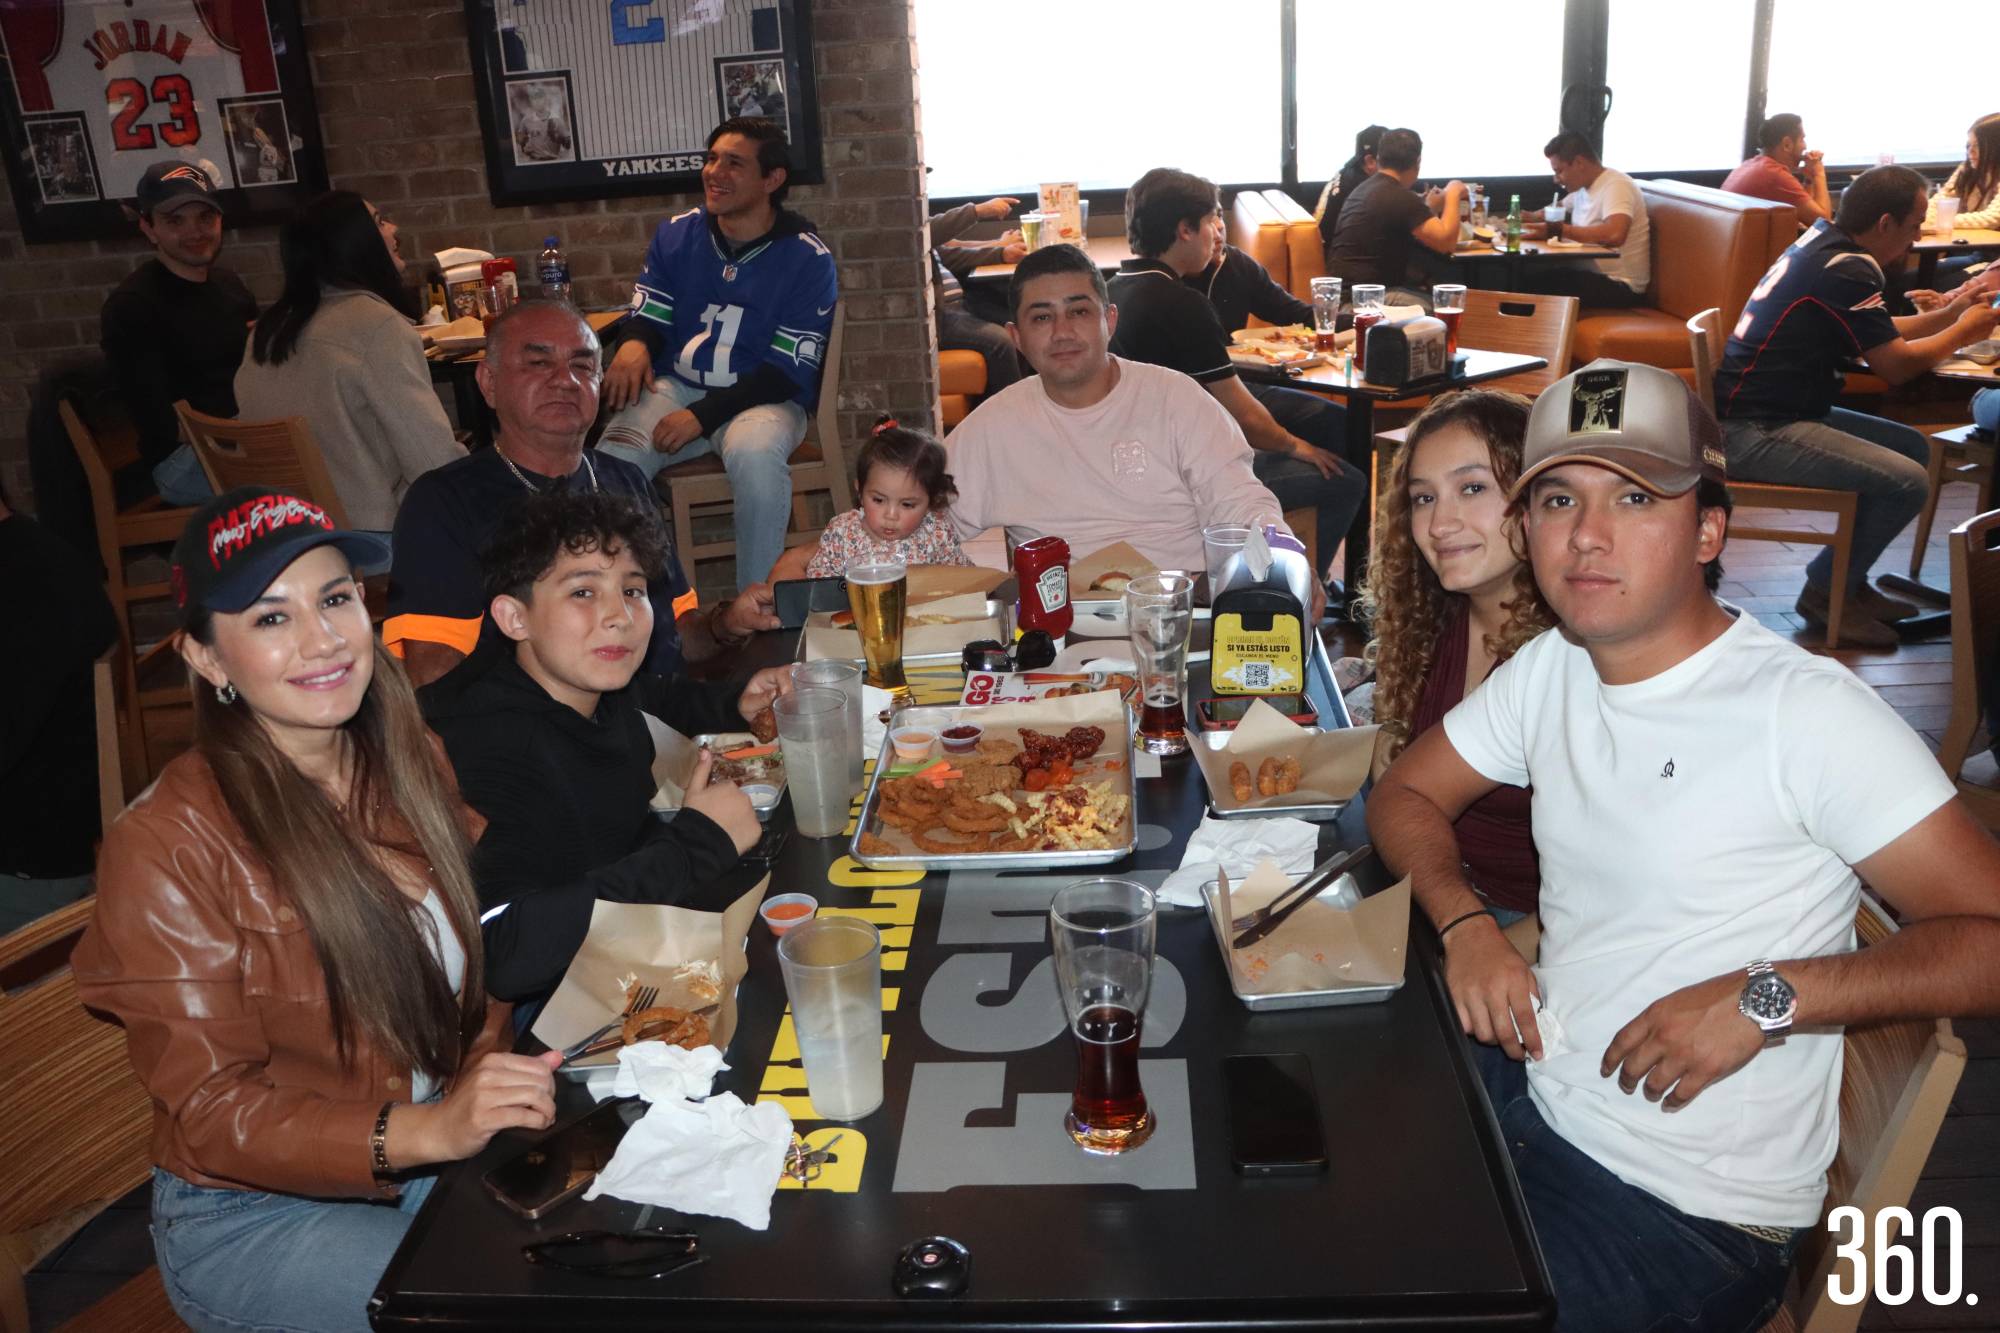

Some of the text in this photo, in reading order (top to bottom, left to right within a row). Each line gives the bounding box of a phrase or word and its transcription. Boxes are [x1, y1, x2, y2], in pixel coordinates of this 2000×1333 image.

[83, 19, 193, 71] JORDAN
[105, 74, 202, 151] 23
[602, 155, 704, 177] YANKEES
[673, 303, 745, 388] 11
[1246, 643, 1268, 652] ESTÁS
